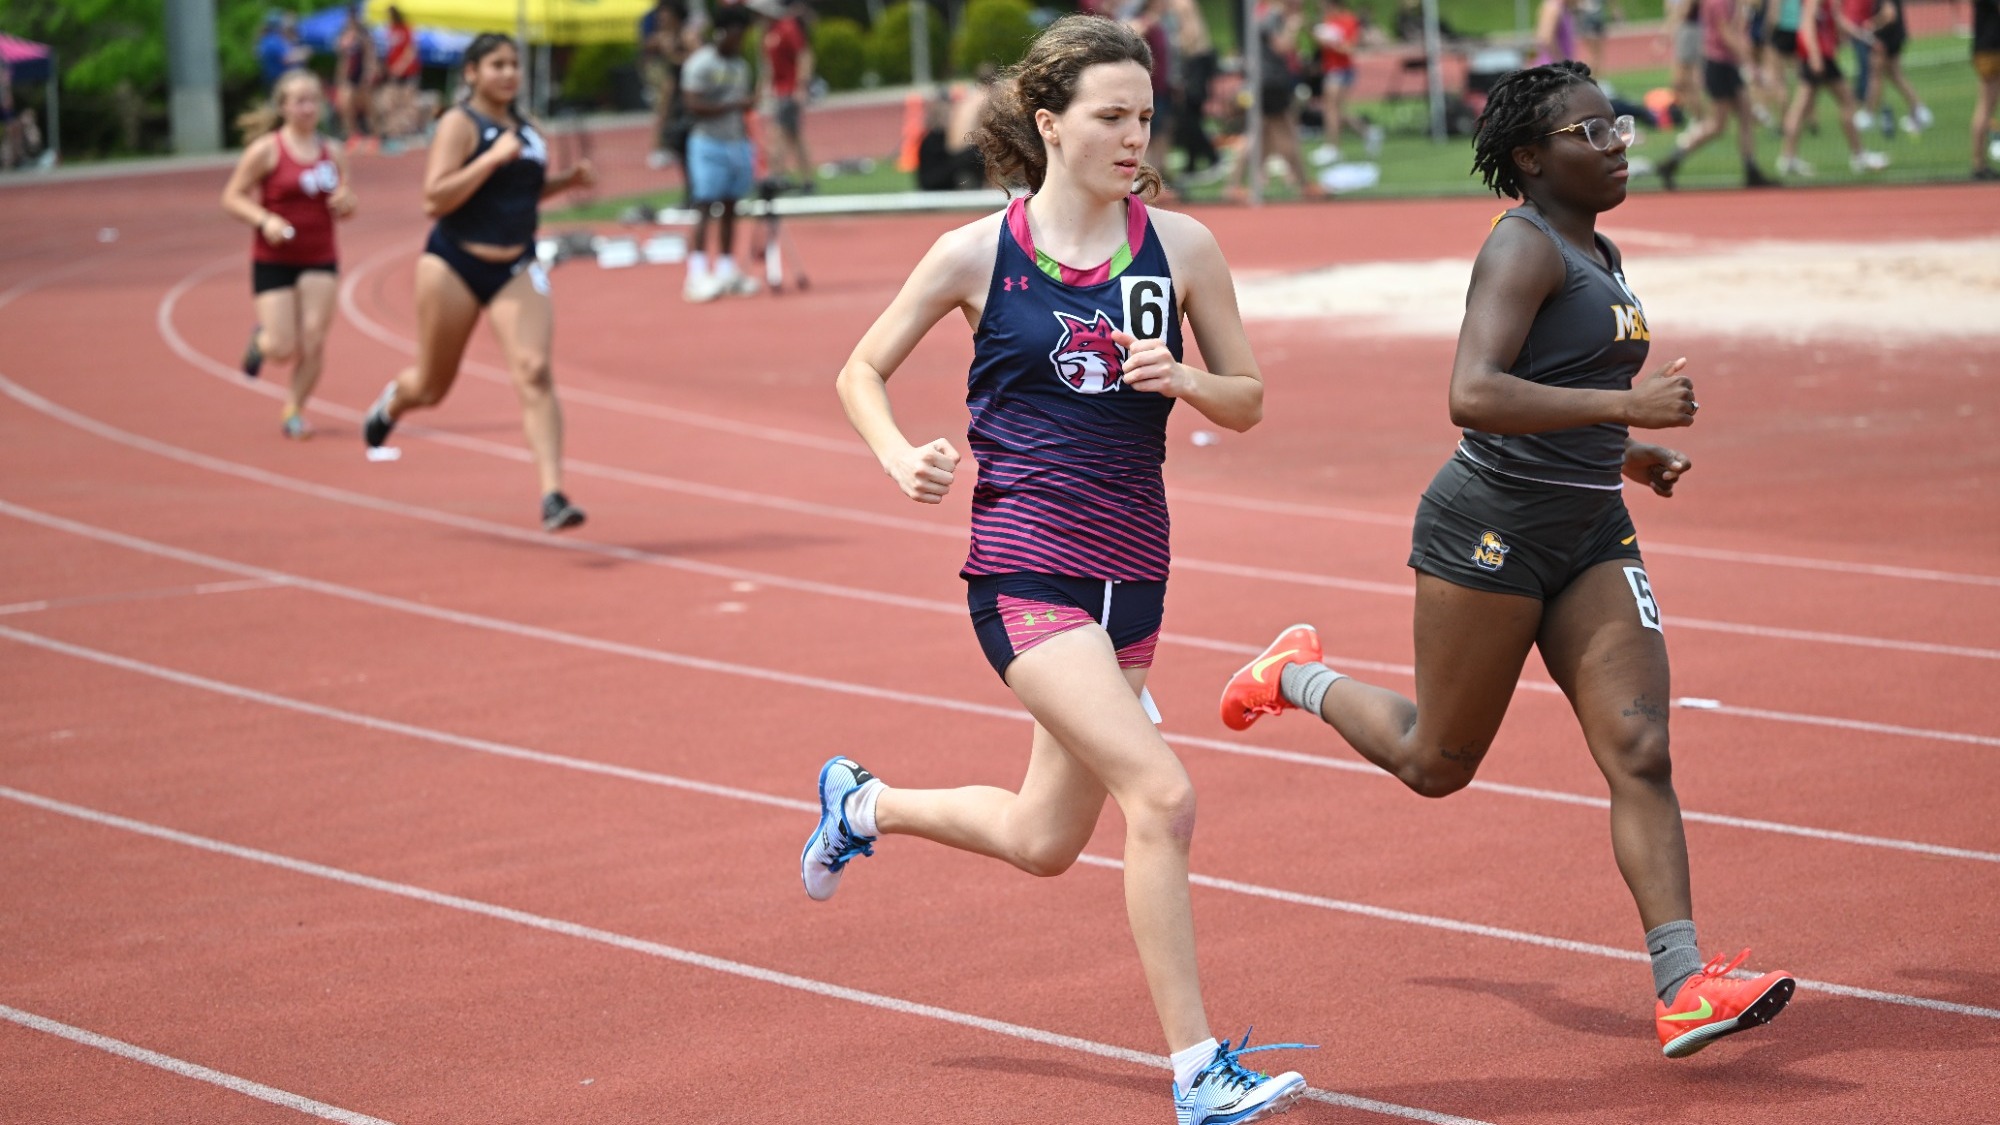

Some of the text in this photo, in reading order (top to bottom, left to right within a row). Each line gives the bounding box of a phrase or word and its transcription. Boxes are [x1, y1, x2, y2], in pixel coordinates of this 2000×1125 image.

[1130, 280, 1163, 340] 6
[1472, 546, 1504, 567] MB
[1632, 571, 1659, 625] 5
